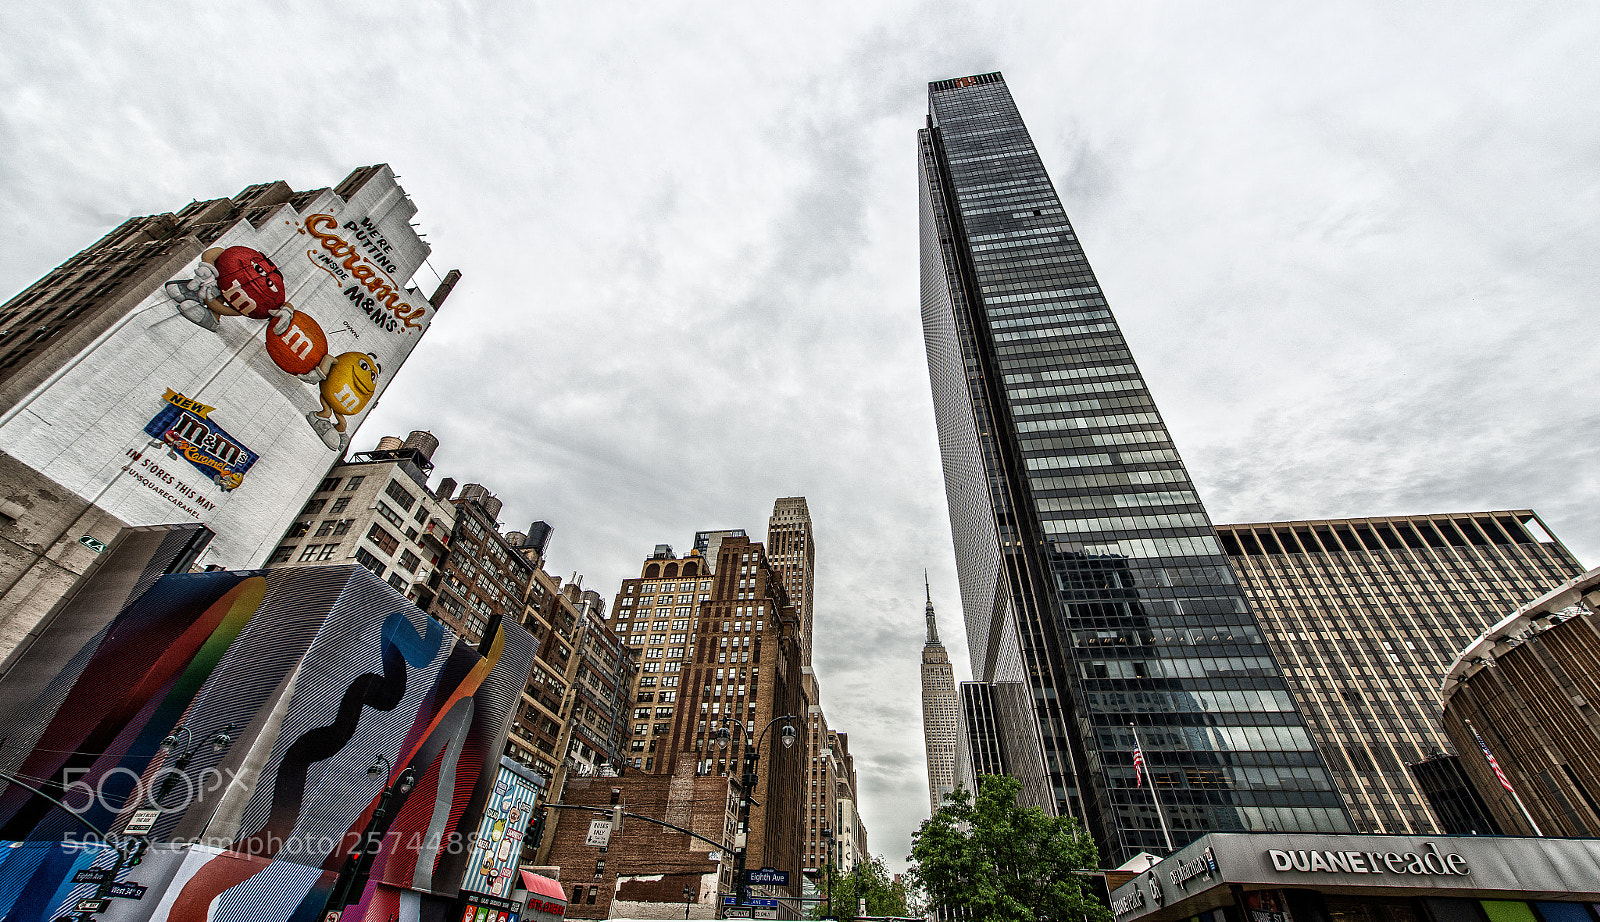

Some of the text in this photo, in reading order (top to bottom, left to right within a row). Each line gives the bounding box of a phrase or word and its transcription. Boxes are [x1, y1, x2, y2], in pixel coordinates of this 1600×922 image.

[343, 220, 396, 274] PUTTING
[360, 216, 393, 254] WE'RE
[305, 213, 425, 332] Caramel
[318, 254, 349, 280] INSIDE
[282, 323, 314, 361] m
[169, 394, 206, 414] NEW
[334, 384, 360, 412] m
[125, 448, 216, 512] IN STORES THIS MAY
[1268, 841, 1471, 876] DUANE reade
[110, 886, 125, 894] West
[750, 872, 785, 882] Eighth Ave
